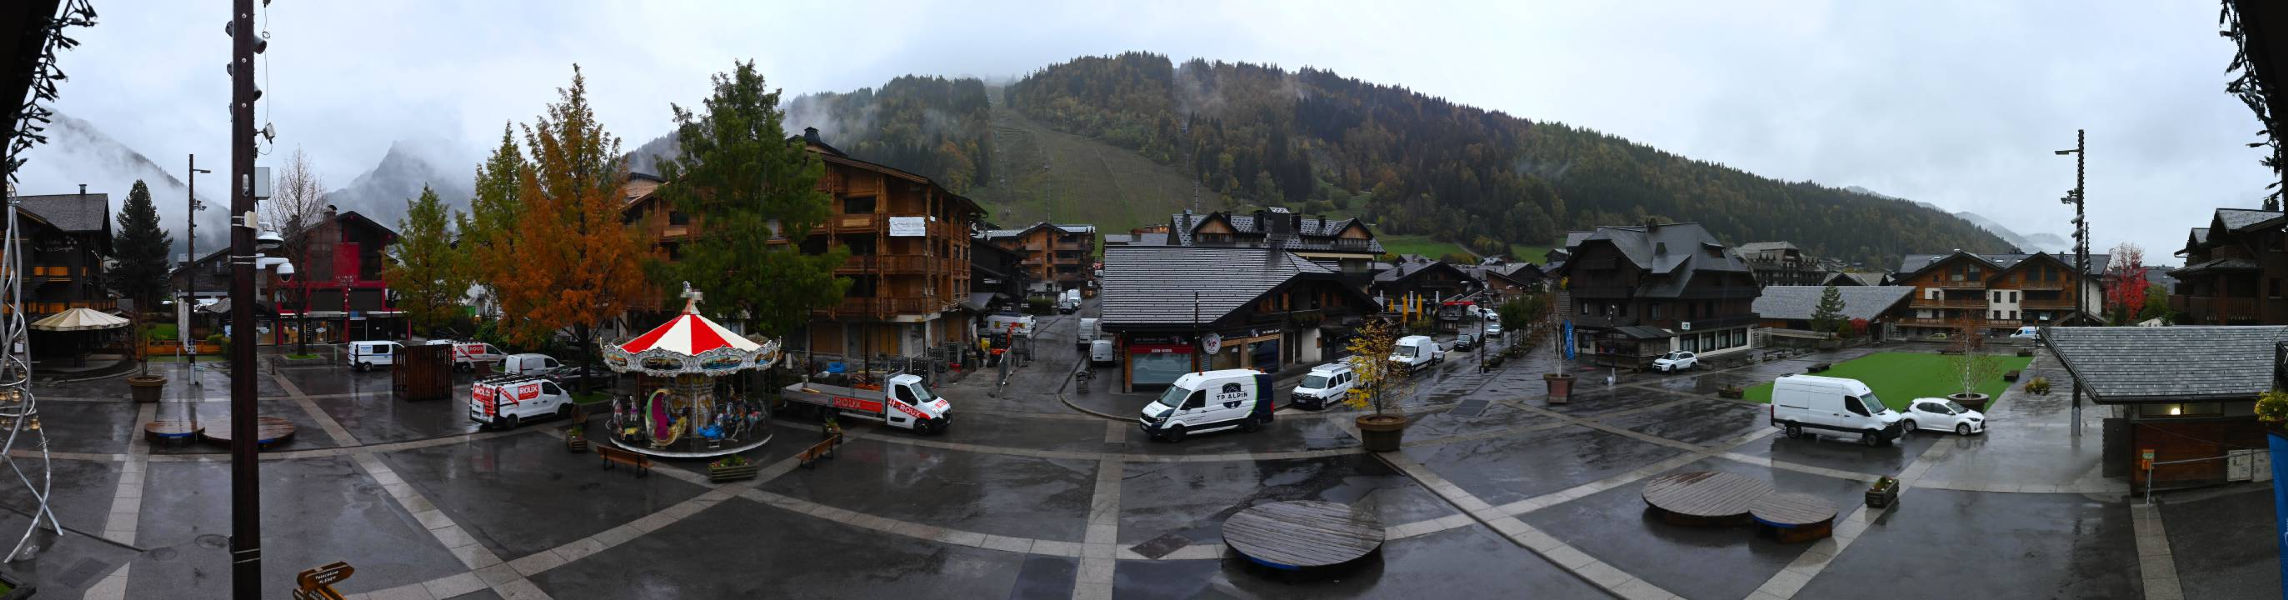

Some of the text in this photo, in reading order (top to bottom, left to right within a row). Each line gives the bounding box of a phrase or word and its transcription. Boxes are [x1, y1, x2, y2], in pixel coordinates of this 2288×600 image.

[518, 384, 538, 394] ROUX
[834, 398, 862, 409] ROUX
[900, 404, 921, 418] ROUX
